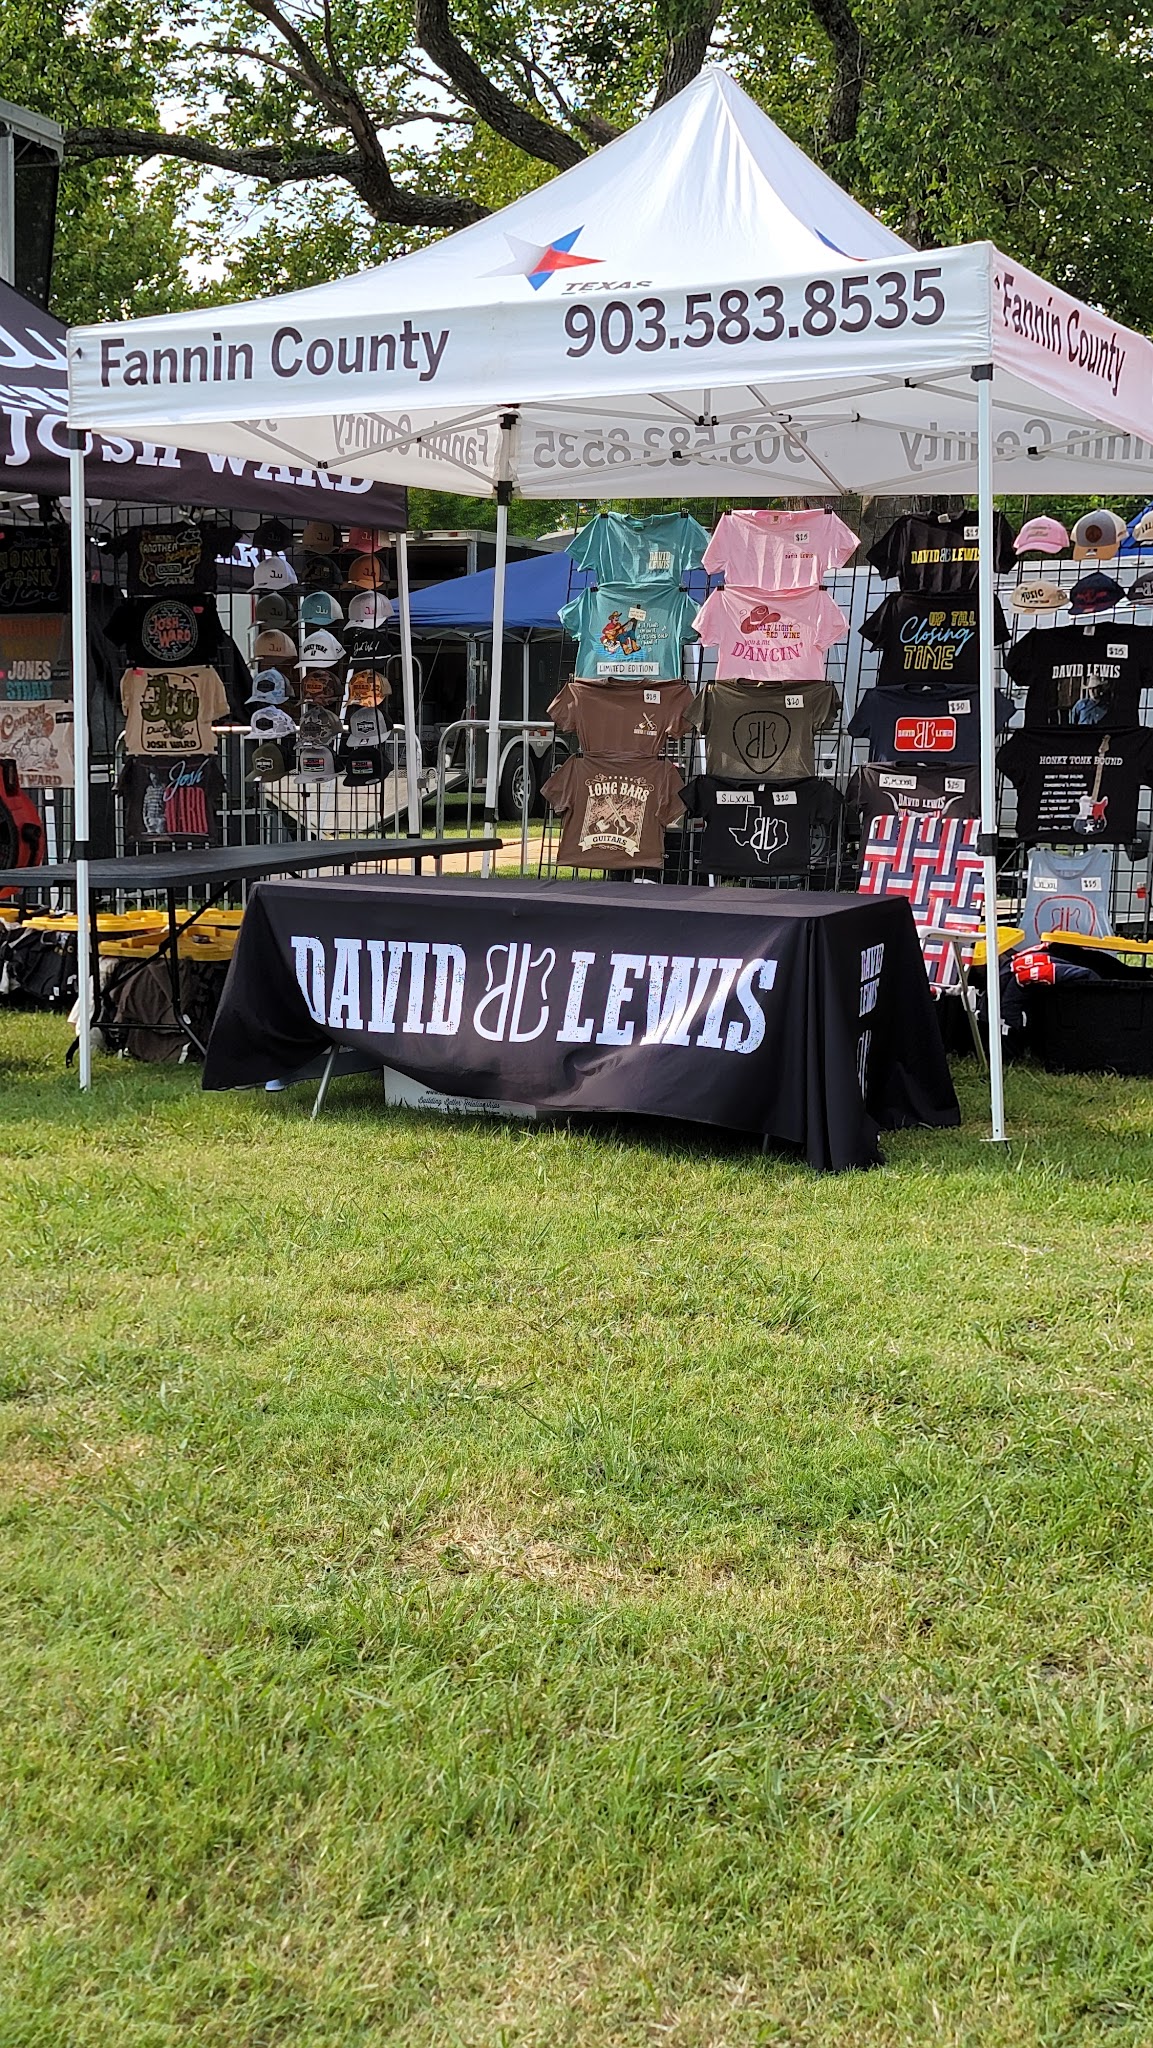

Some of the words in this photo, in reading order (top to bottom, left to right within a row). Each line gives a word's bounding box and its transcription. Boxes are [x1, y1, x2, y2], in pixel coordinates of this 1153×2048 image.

[564, 280, 653, 292] TEXAS
[563, 267, 946, 359] 903.583.8535
[1002, 271, 1062, 355] Fannin
[1066, 309, 1126, 397] County
[100, 332, 254, 388] Fannin
[270, 320, 451, 382] County
[1, 405, 182, 469] JOSH
[143, 543, 178, 553] ANOTHER
[648, 551, 671, 561] DAVID
[911, 549, 940, 564] DAVID
[648, 560, 671, 570] LEWIS
[1020, 588, 1044, 603] MUSIC
[929, 611, 946, 626] UP
[950, 611, 977, 626] TILL
[158, 629, 192, 648] WARD
[900, 616, 975, 656] Closing
[731, 641, 805, 662] DANCIN'
[903, 645, 956, 670] TIME
[7, 660, 52, 681] JONES
[599, 664, 626, 673] LIMITED
[628, 665, 654, 673] EDITION
[1052, 664, 1084, 680] DAVID
[1087, 663, 1121, 679] LEWIS
[6, 680, 53, 700] STRAIT
[146, 740, 167, 749] JOSH
[169, 740, 197, 749] WARD
[1039, 755, 1068, 765] HONKY
[1069, 755, 1093, 765] TONK
[1093, 756, 1123, 766] BOUND
[28, 774, 63, 786] WARD
[163, 758, 210, 802] Josh
[588, 783, 618, 797] LONG
[619, 782, 650, 802] BARS
[898, 793, 920, 808] DAVID
[922, 795, 946, 809] LEWIS
[592, 835, 628, 846] GUITARS
[860, 942, 885, 983] DAVID
[290, 934, 467, 1037] DAVID
[556, 949, 778, 1056] LEWIS
[858, 977, 880, 1018] LEWIS
